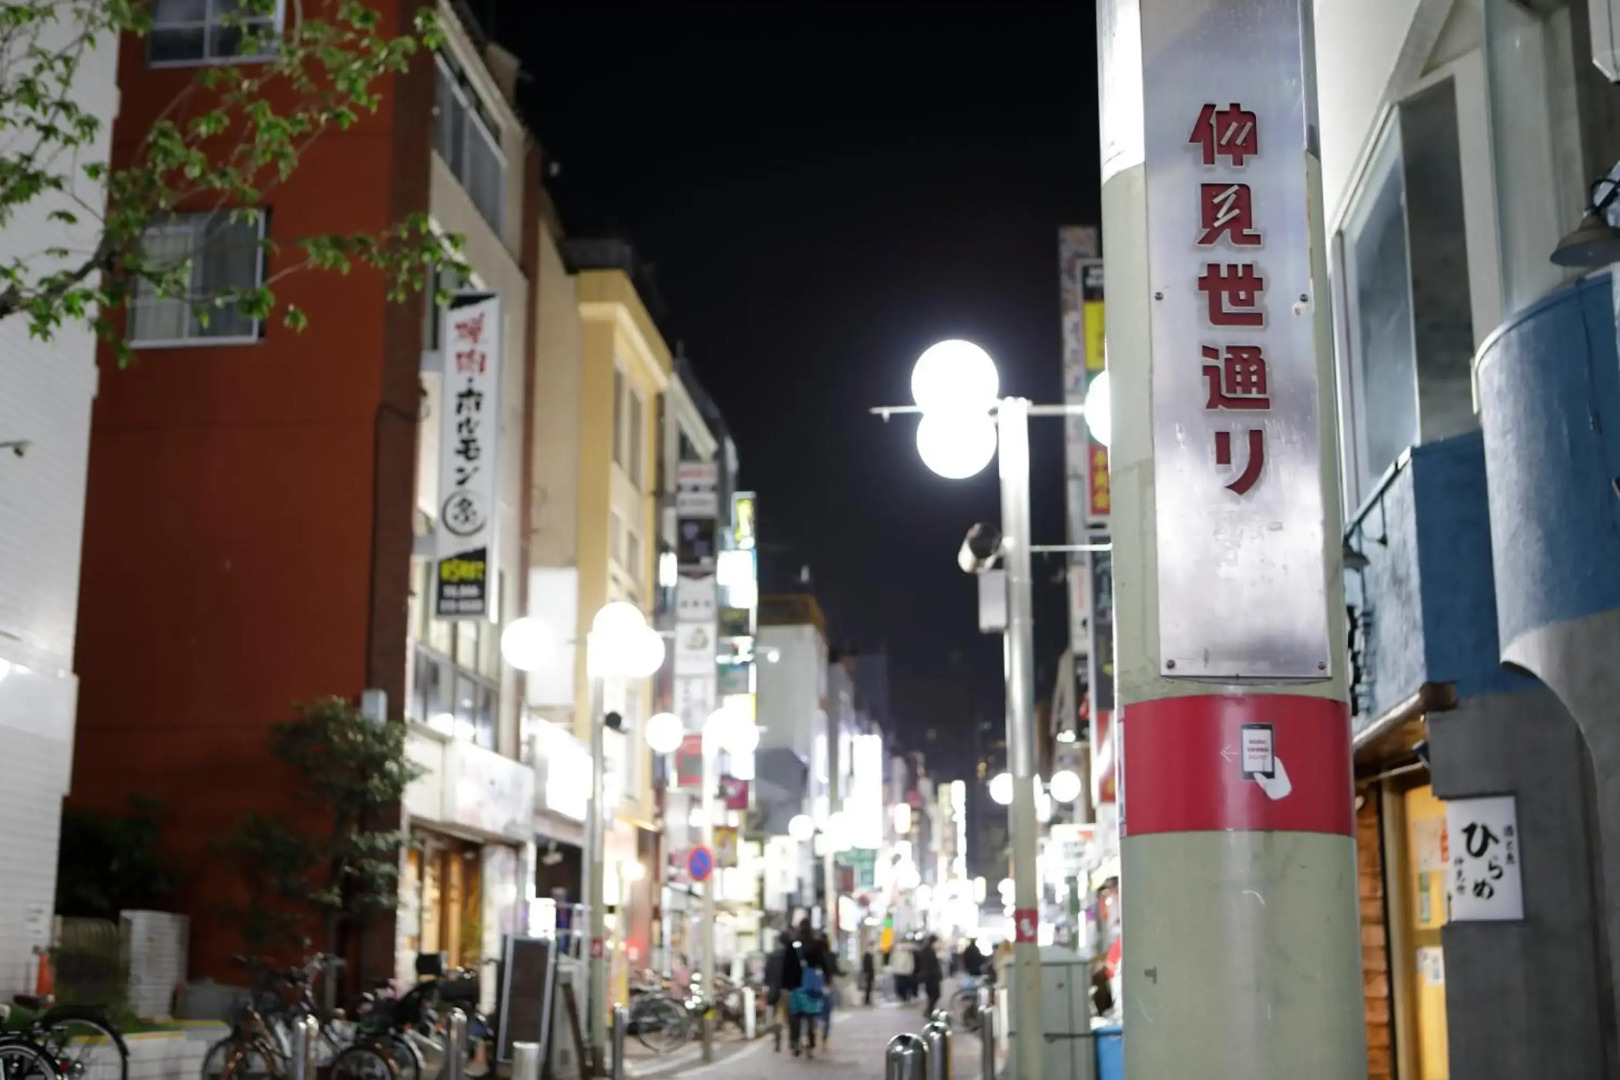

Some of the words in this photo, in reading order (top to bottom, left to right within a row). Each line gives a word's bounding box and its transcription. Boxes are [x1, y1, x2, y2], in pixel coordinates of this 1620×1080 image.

[1188, 102, 1271, 496] 仲見世通り
[1461, 821, 1504, 900] ひらめ
